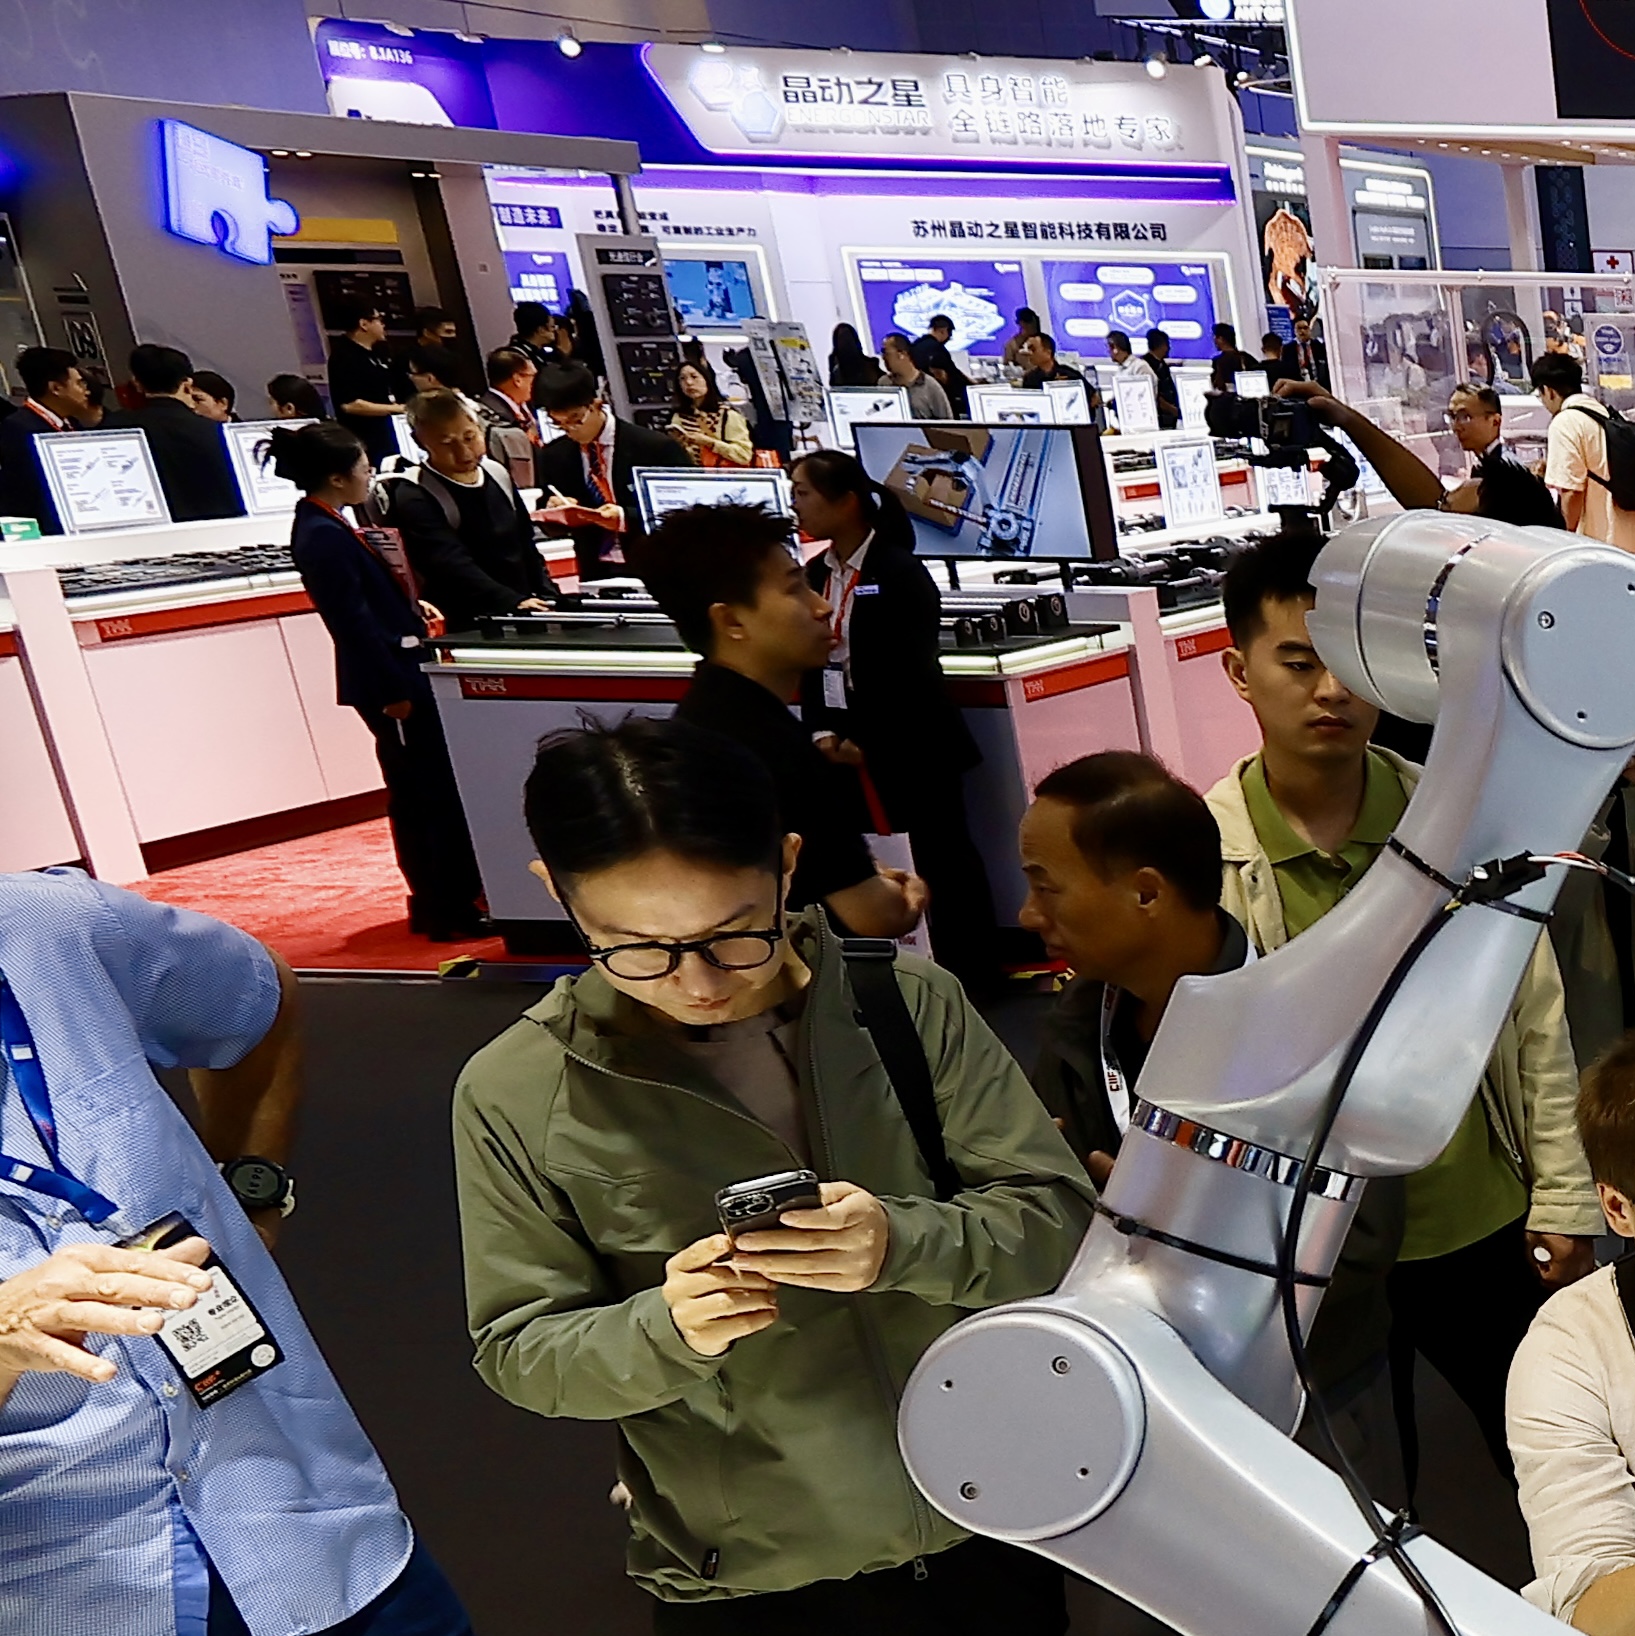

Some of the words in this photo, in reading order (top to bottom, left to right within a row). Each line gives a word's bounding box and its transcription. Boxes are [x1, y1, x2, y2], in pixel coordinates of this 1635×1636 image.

[782, 74, 926, 108] 晶动之星
[943, 73, 1070, 105] 具身智能
[786, 106, 930, 127] ENERGONSTAR
[950, 108, 1175, 143] 全链路落地专家
[911, 219, 1168, 242] 苏州晶动之星智能科技有限公司
